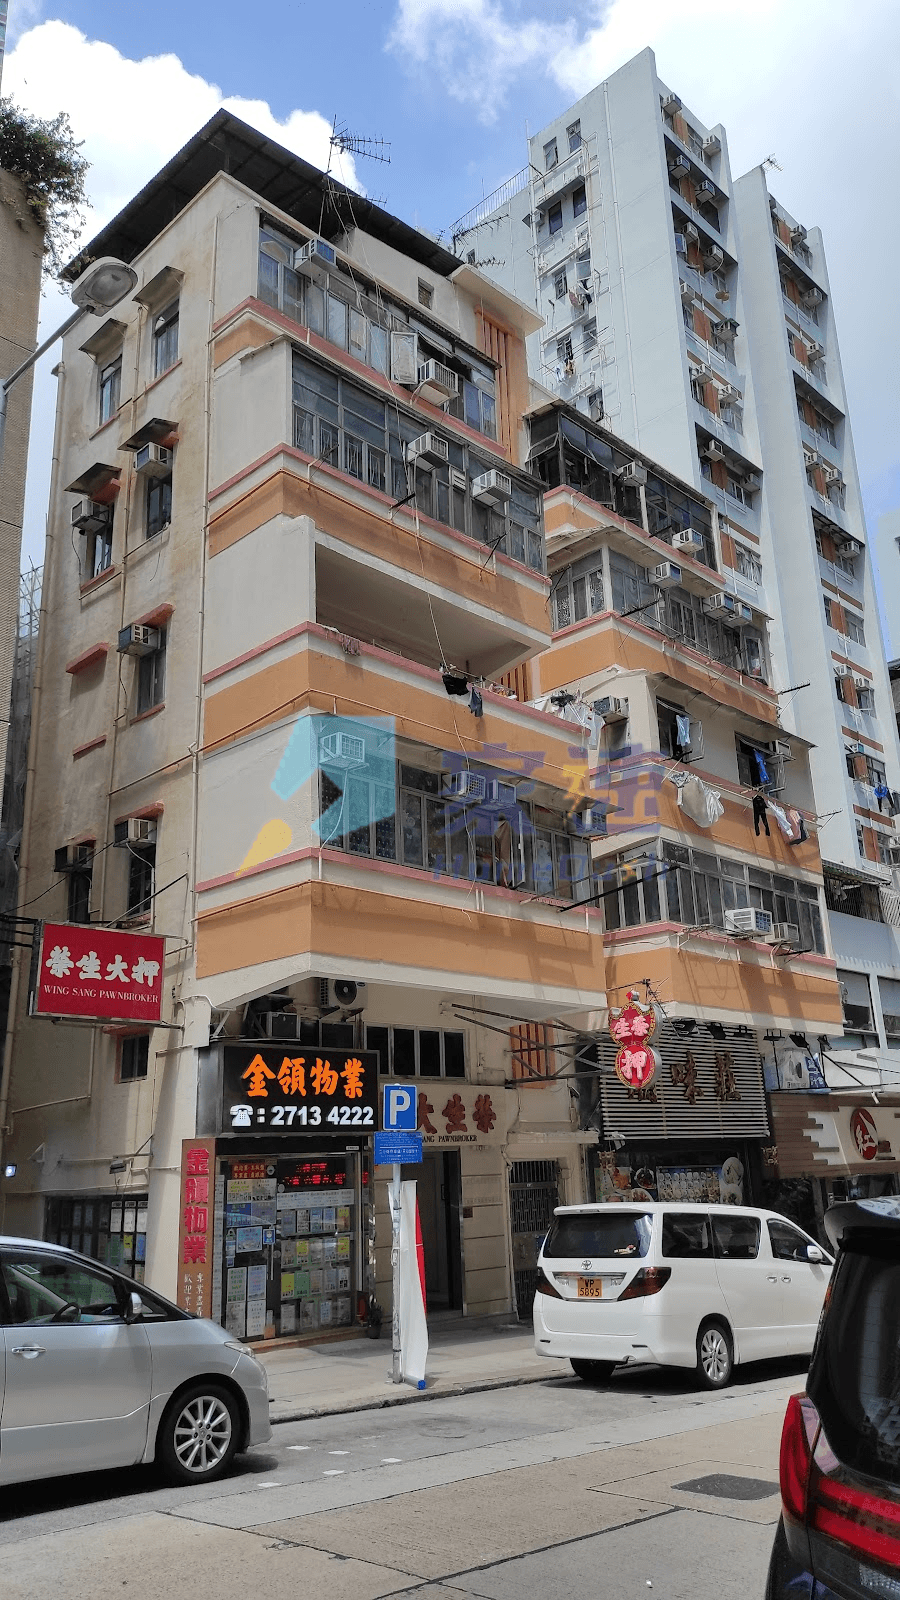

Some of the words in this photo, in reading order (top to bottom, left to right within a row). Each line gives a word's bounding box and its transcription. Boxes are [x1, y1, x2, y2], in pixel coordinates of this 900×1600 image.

[46, 945, 160, 987] 榮生大押
[43, 985, 70, 996] WING
[71, 988, 97, 998] SANG
[99, 990, 158, 1003] PAWNBROKER
[242, 1054, 366, 1098] 金領物業
[621, 1050, 647, 1080] 押
[270, 1106, 322, 1125] 2713
[326, 1105, 374, 1125] 4222
[389, 1090, 411, 1125] P
[422, 1135, 434, 1143] ANG
[438, 1134, 477, 1143] PAWNBROKER
[184, 1148, 209, 1264] 金領物業
[580, 1287, 599, 1296] 5895
